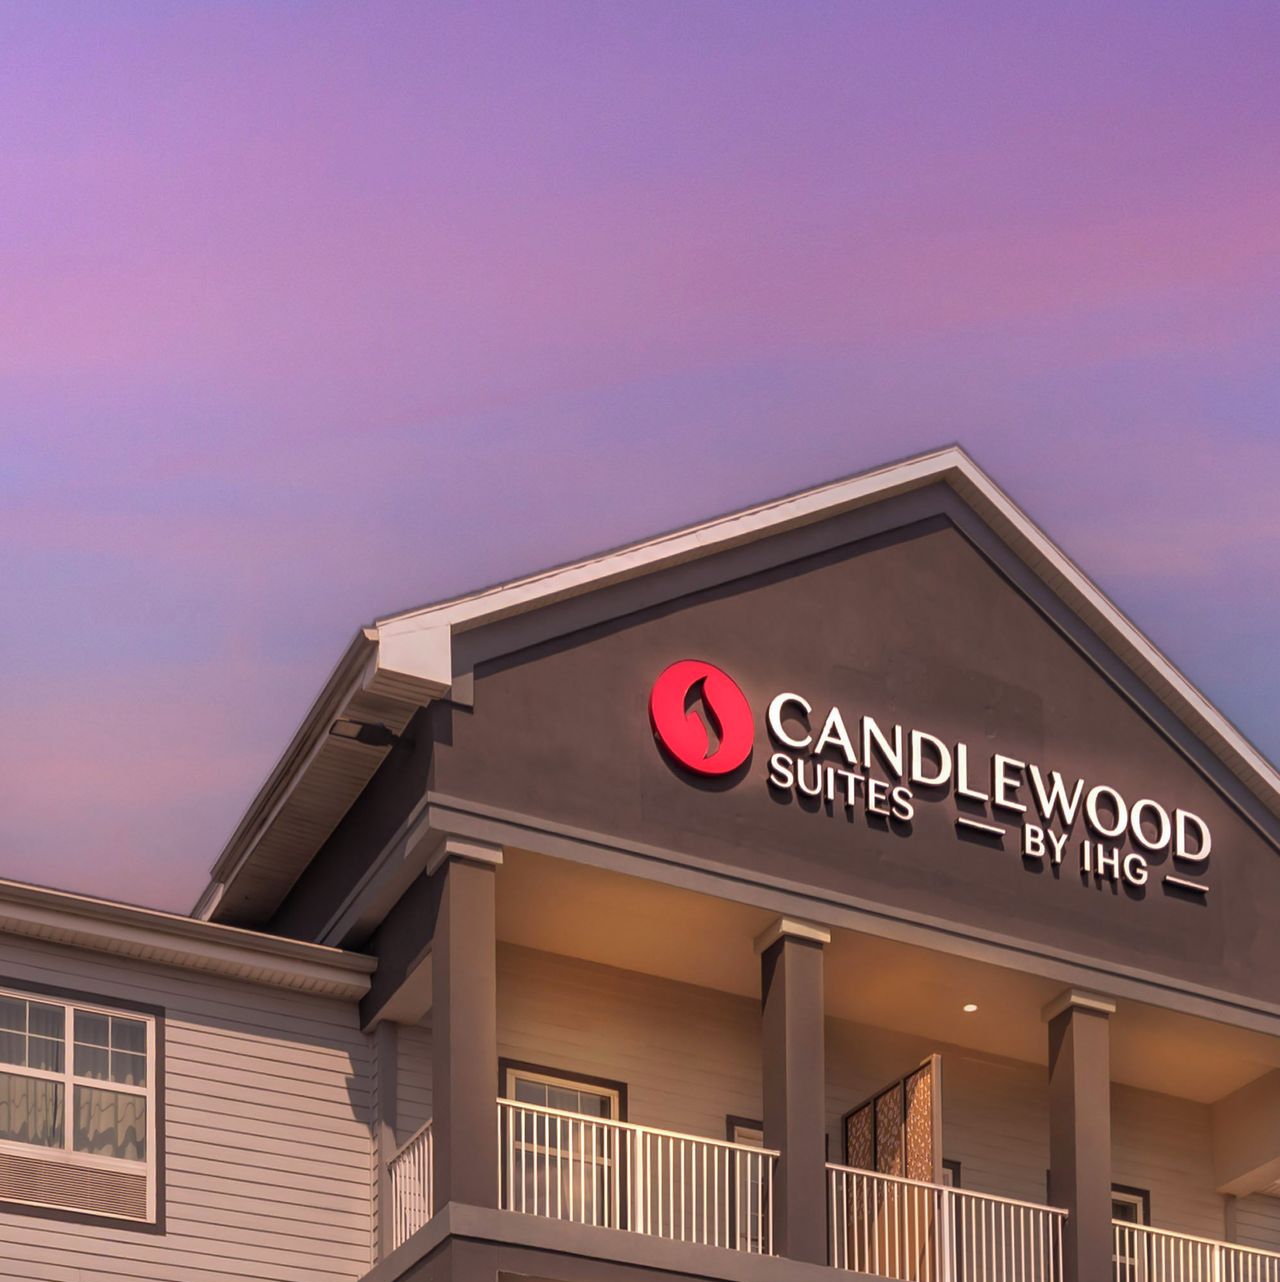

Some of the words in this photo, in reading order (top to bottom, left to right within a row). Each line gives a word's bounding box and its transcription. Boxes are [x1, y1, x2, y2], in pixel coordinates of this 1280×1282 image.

[768, 692, 1212, 862] CANDLEWOOD
[769, 752, 915, 821] SUITES
[1023, 823, 1068, 864] BY
[1083, 840, 1148, 886] IHG
